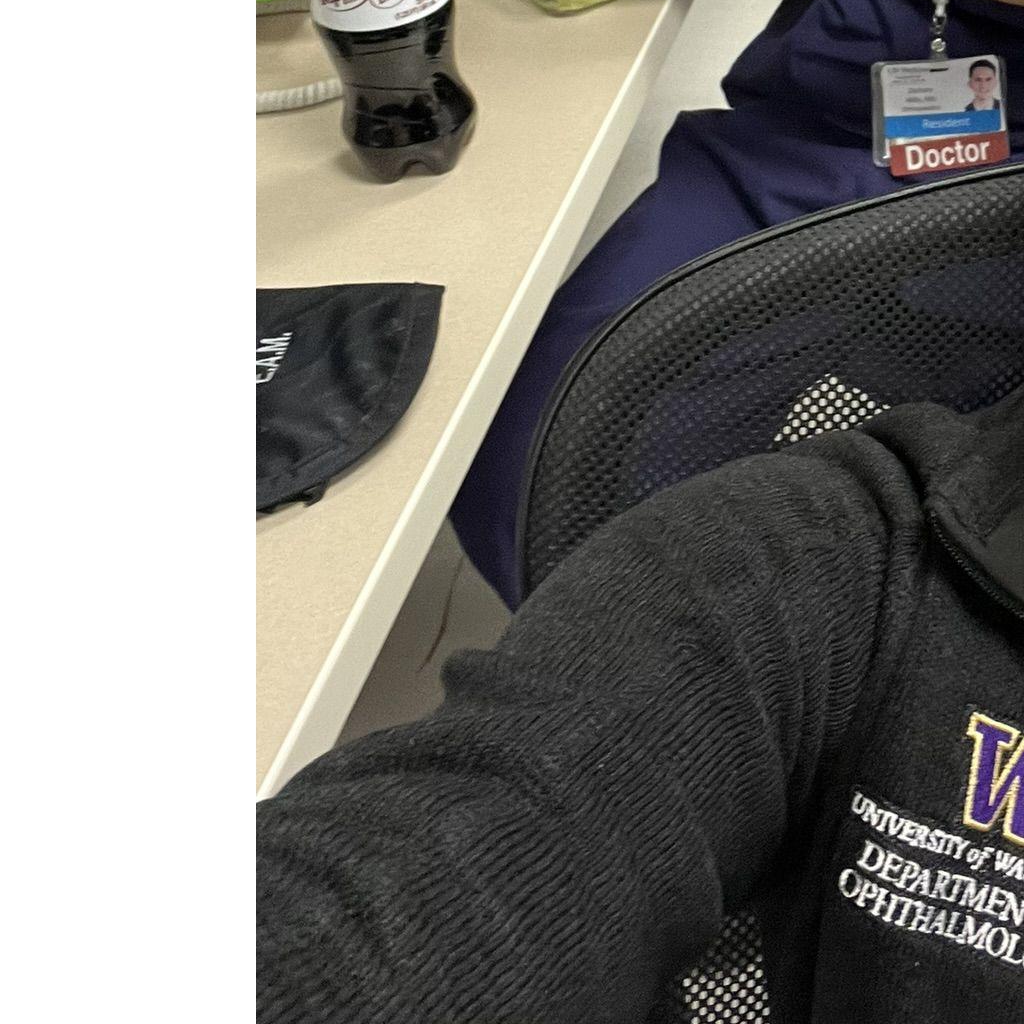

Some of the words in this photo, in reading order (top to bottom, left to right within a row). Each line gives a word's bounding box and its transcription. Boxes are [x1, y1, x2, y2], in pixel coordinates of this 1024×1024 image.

[922, 118, 971, 129] Resident
[905, 140, 990, 171] Doctor
[851, 791, 971, 860] UNIVERSITY
